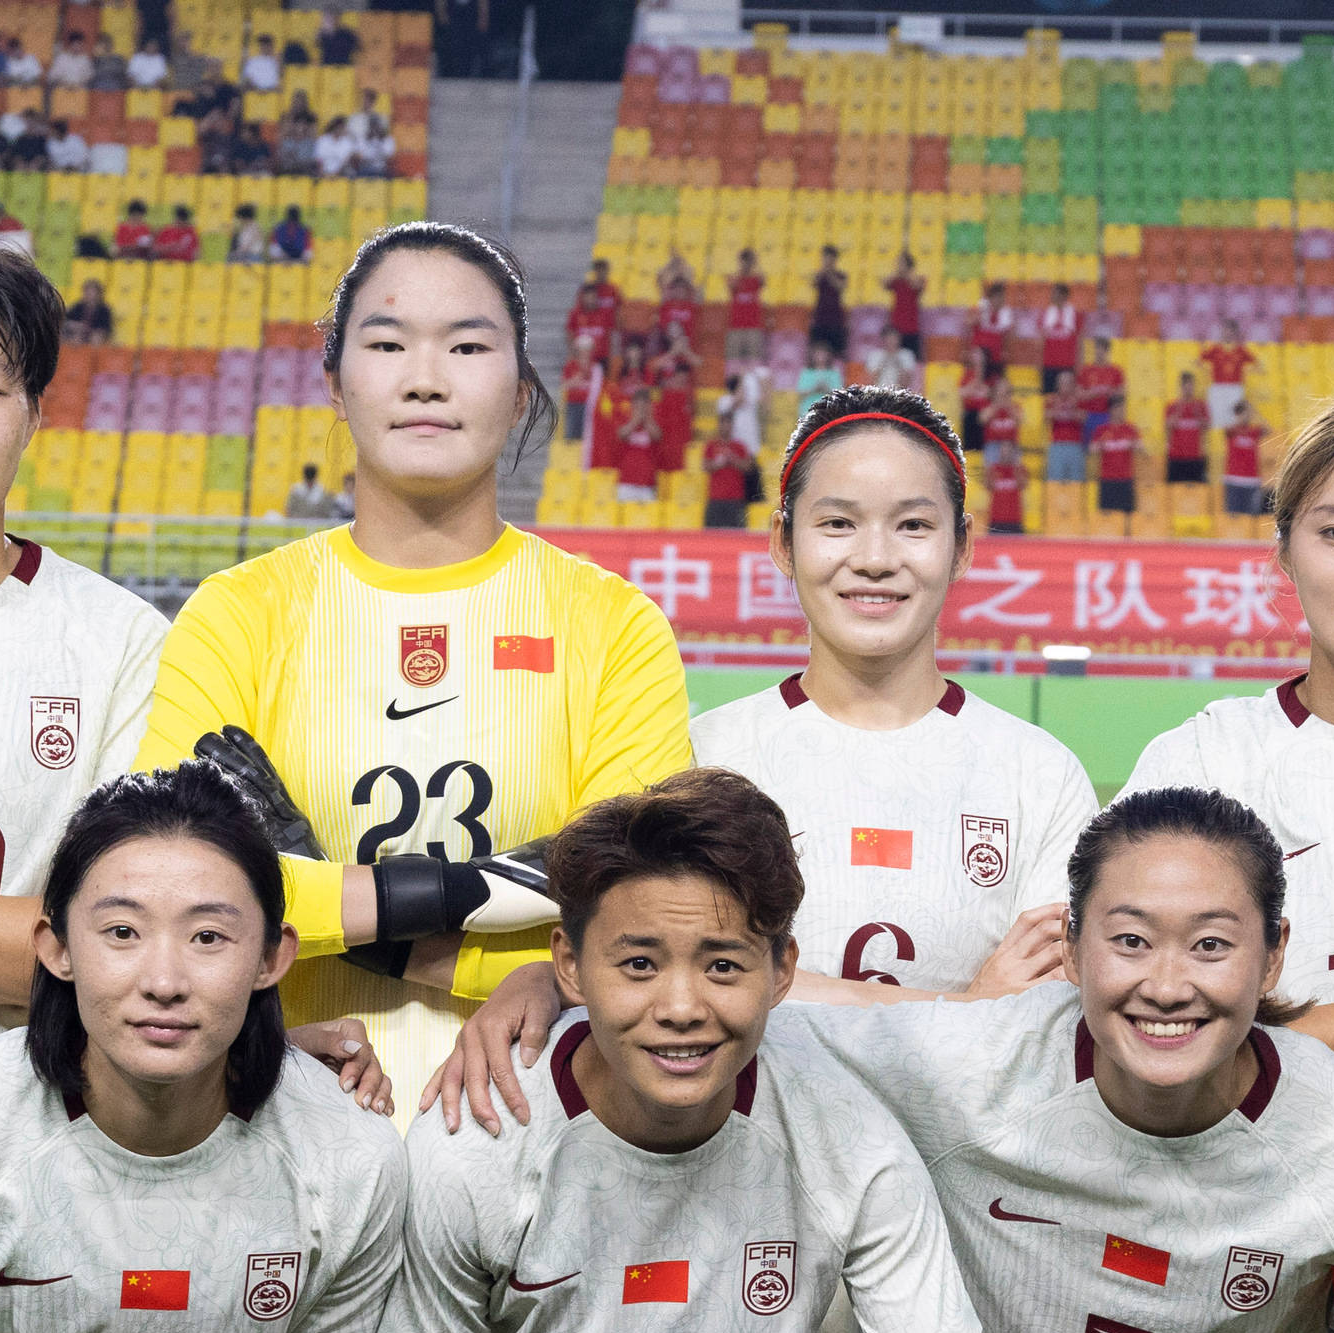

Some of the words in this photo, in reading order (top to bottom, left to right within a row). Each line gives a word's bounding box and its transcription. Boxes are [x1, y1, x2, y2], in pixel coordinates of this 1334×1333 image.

[403, 627, 445, 640] CFA
[1015, 635, 1211, 658] Aociation
[35, 701, 75, 715] CFA
[352, 760, 494, 866] 23
[965, 819, 1004, 835] CFA
[841, 921, 916, 988] 6
[749, 1246, 792, 1260] CFA
[1232, 1251, 1278, 1268] CFA
[252, 1256, 296, 1270] CFA
